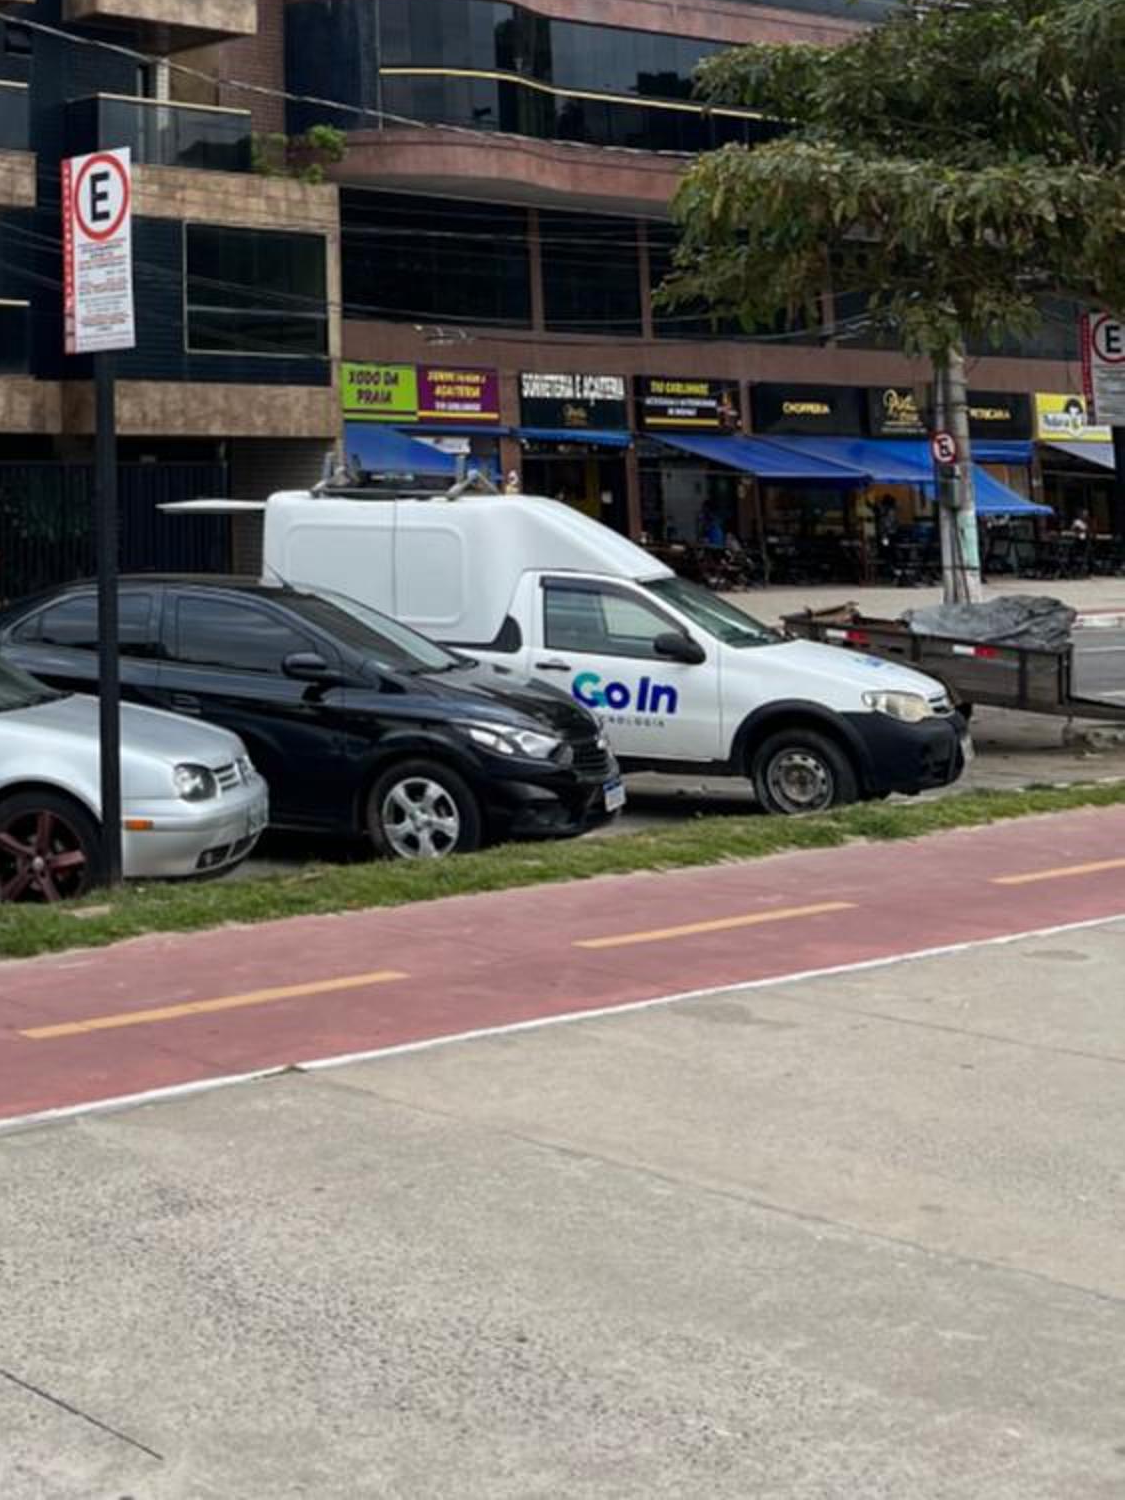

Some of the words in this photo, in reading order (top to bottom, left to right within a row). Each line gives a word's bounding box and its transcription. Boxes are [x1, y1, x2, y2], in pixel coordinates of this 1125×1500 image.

[90, 171, 111, 222] E
[1104, 325, 1122, 353] E
[383, 372, 399, 386] DA
[357, 389, 392, 404] PRAIA
[572, 672, 630, 709] Go
[636, 676, 678, 714] In
